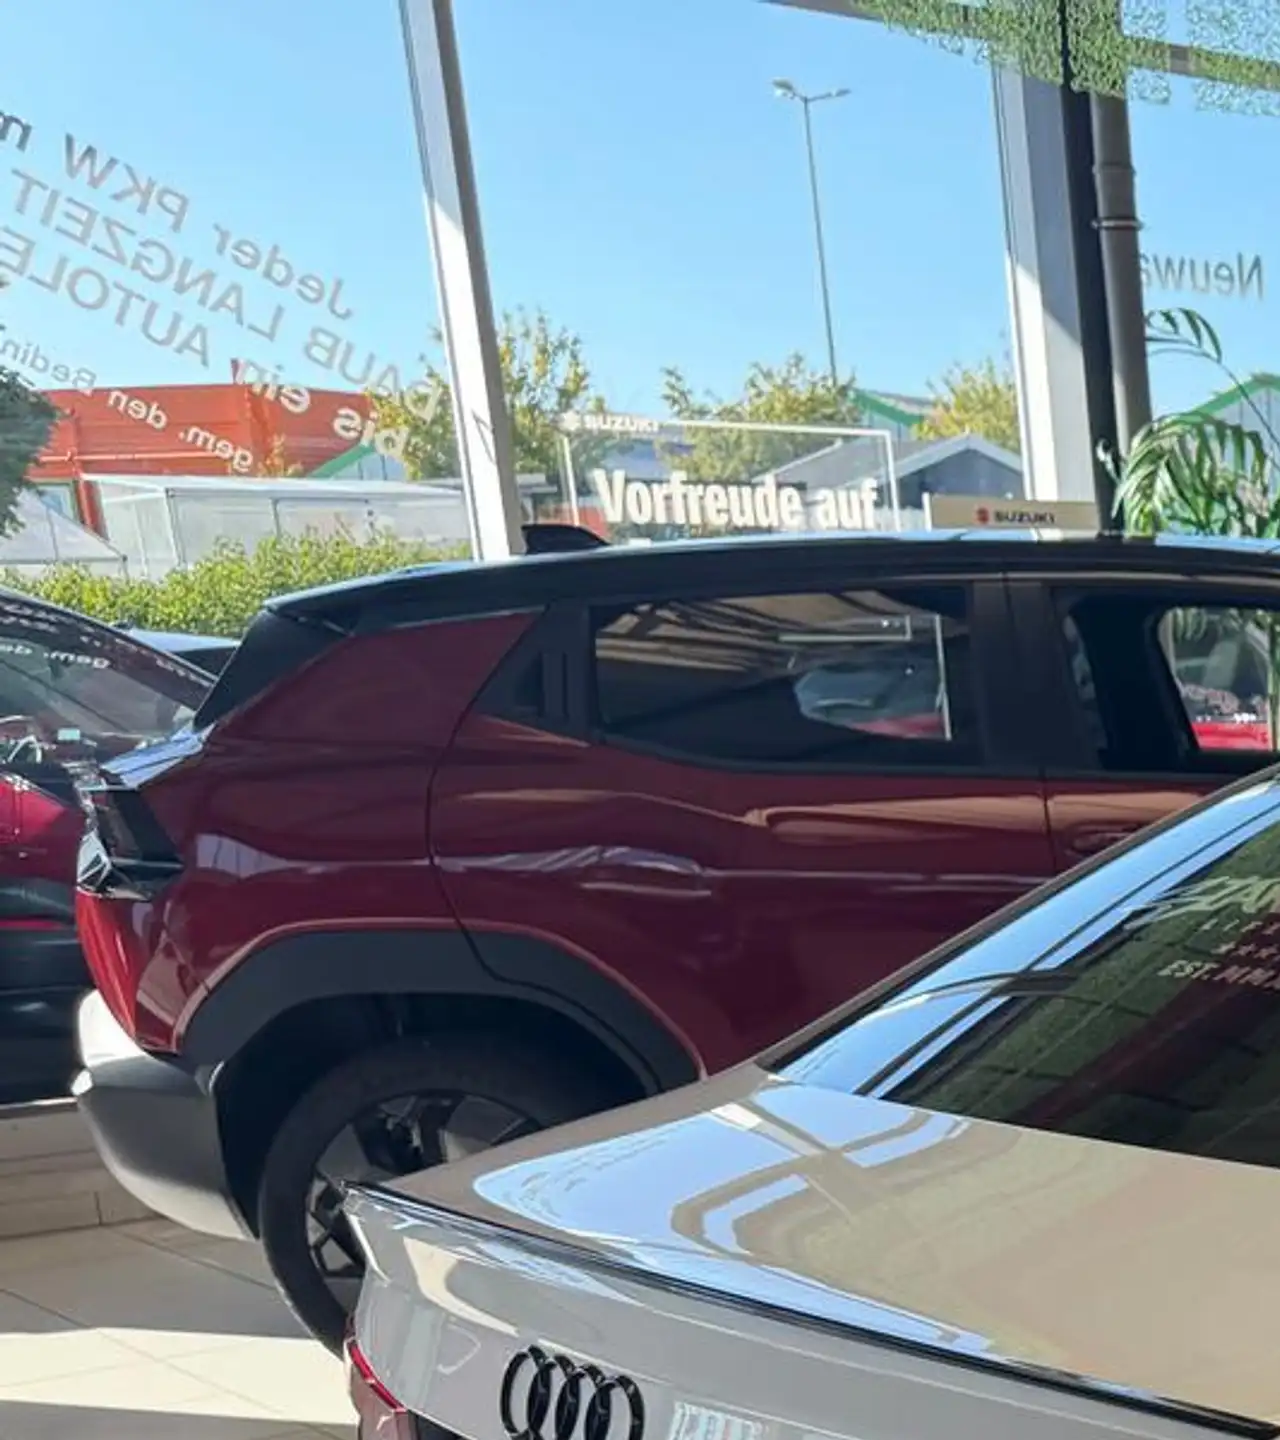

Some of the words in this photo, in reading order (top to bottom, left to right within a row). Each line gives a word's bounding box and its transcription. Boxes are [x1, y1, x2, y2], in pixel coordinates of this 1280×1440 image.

[594, 468, 804, 527] Vorfreude
[817, 477, 878, 531] auf
[995, 510, 1056, 525] SUZUKI
